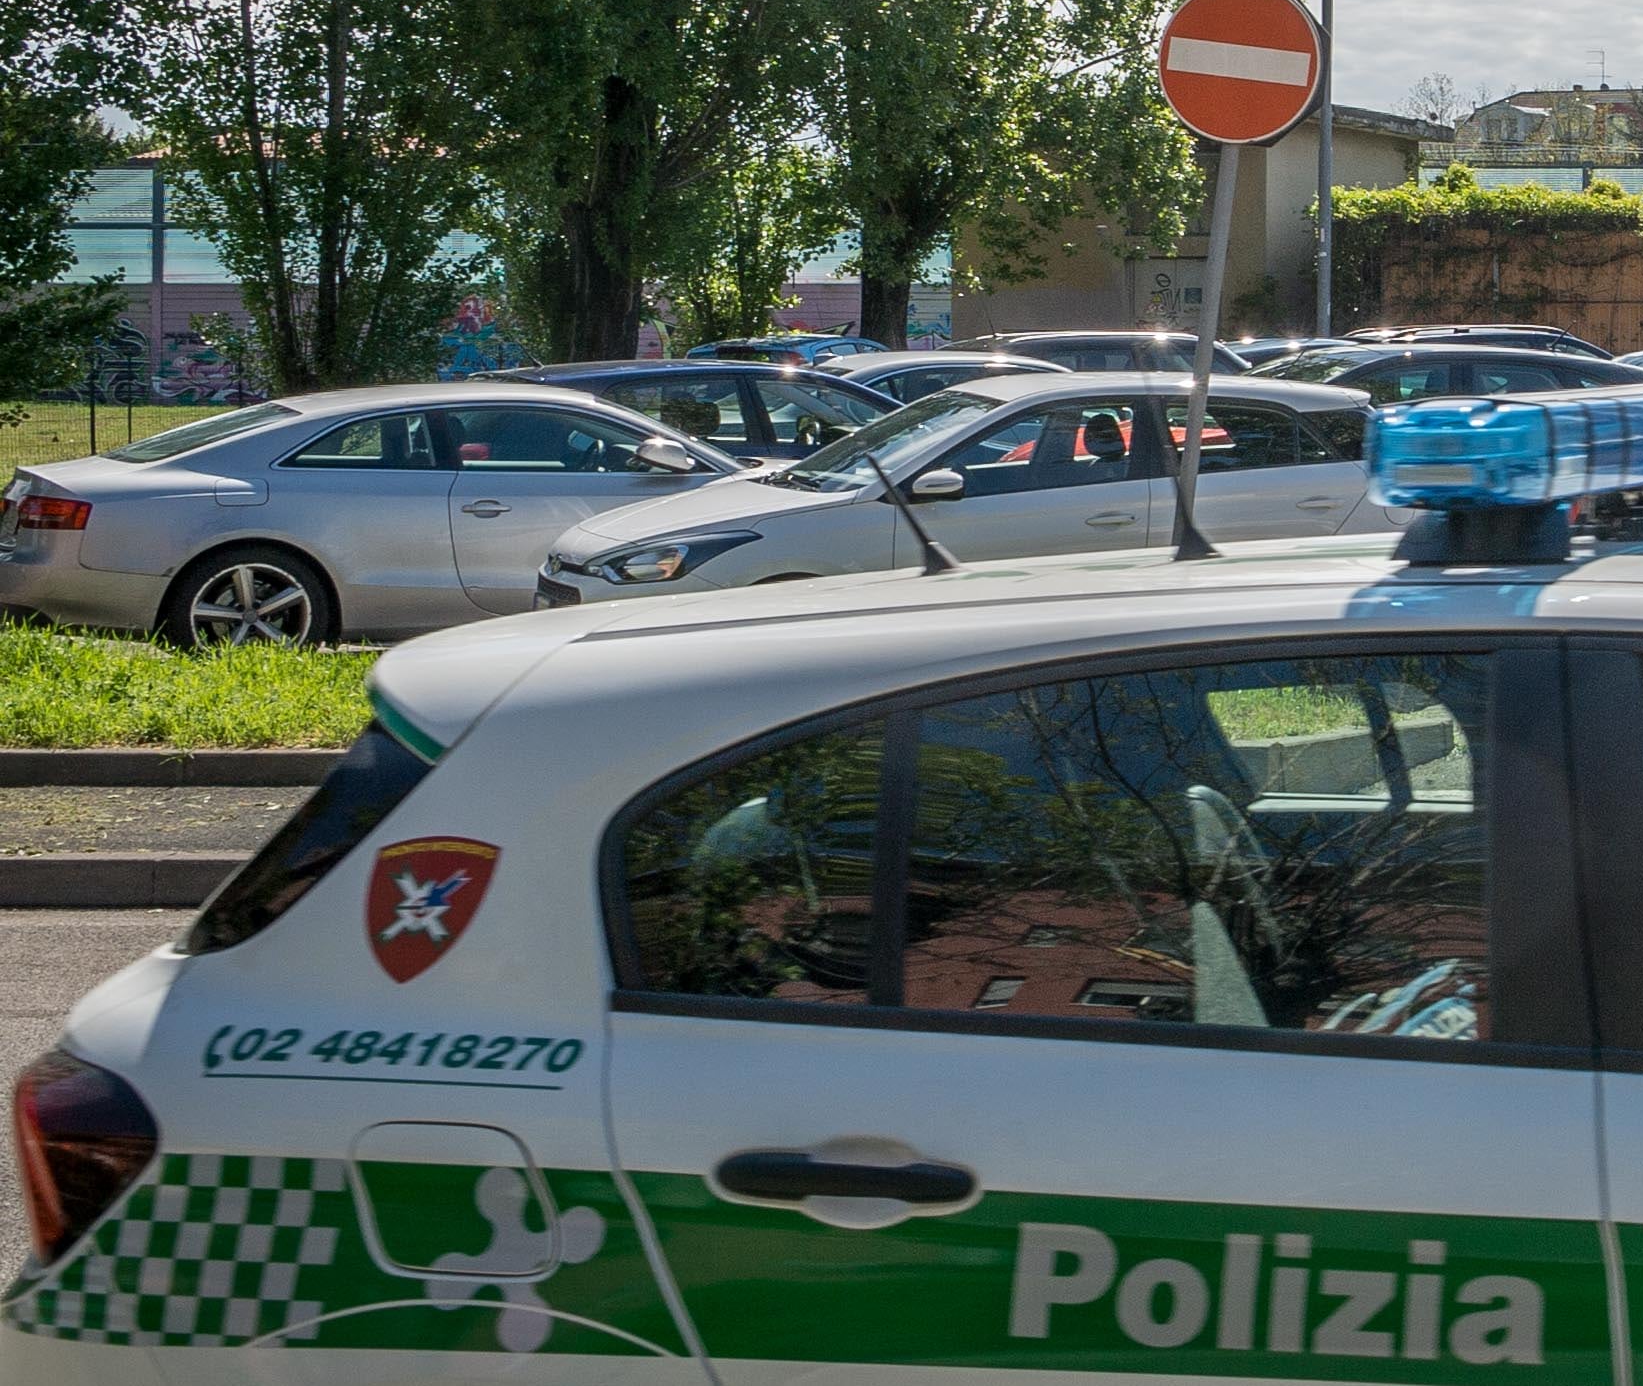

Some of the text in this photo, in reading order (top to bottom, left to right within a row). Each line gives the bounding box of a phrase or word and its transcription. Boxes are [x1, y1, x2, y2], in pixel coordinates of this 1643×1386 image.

[230, 1028, 584, 1073] 02 48418270
[1009, 1221, 1547, 1366] Polizia
